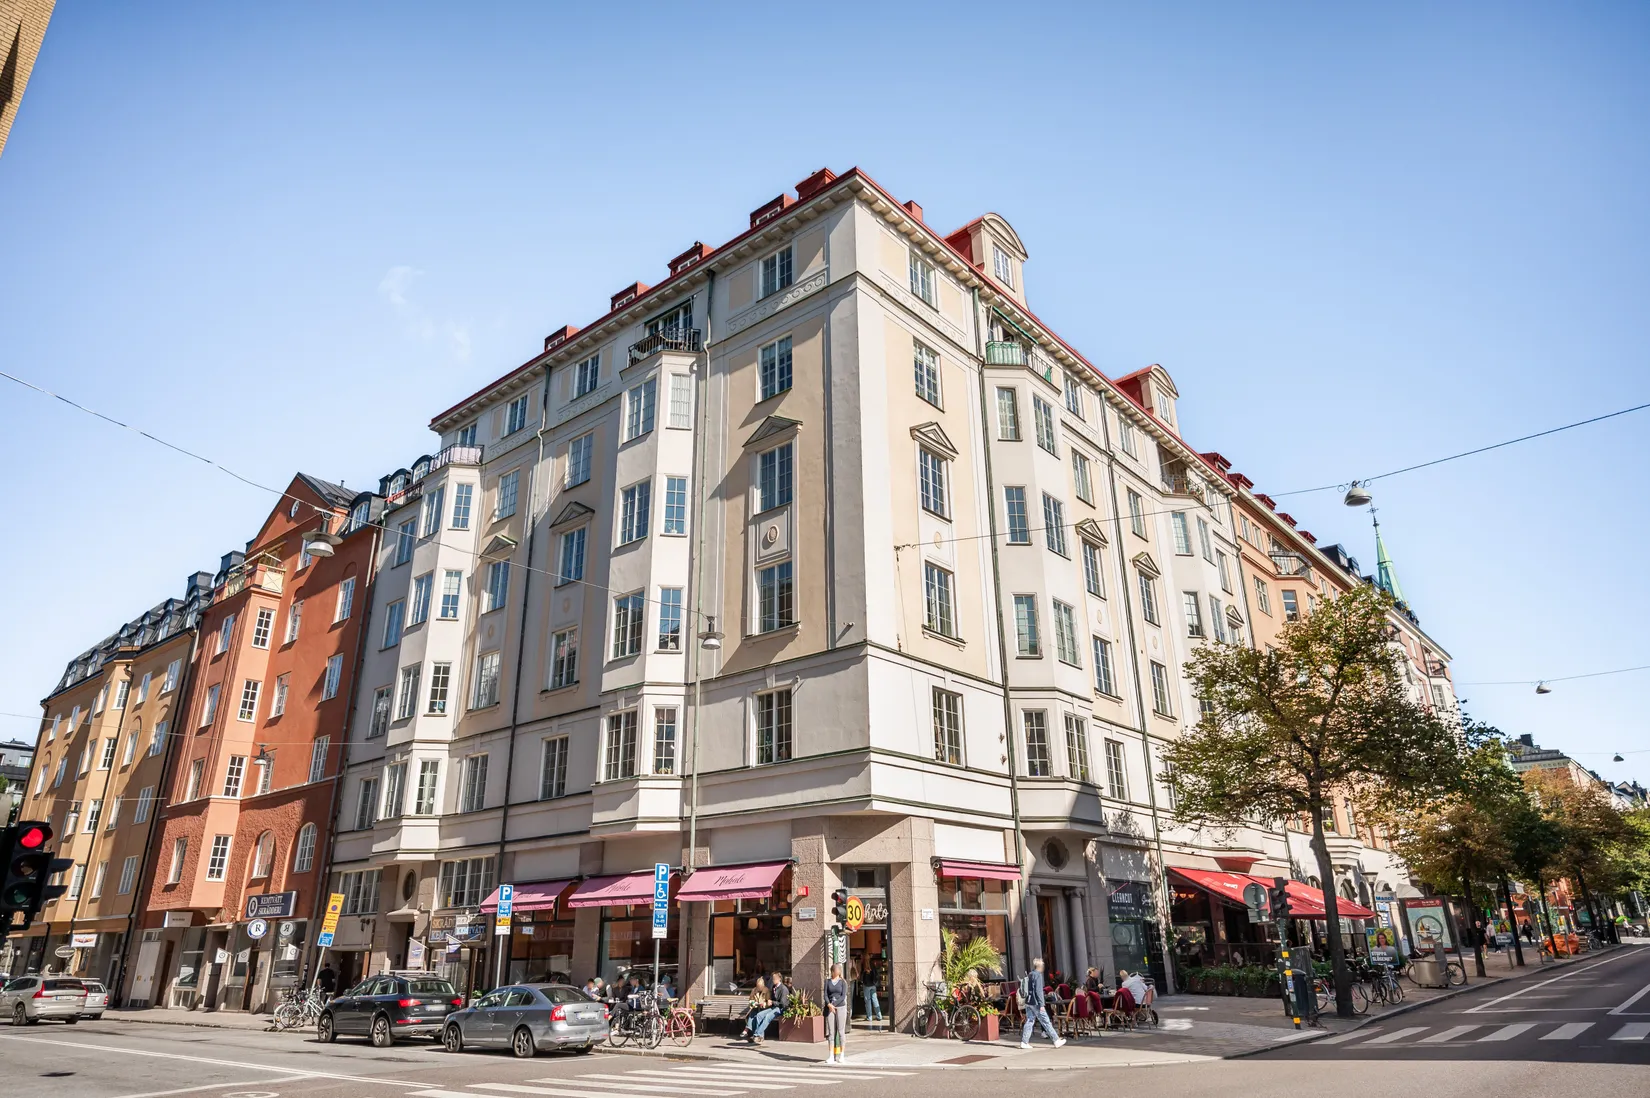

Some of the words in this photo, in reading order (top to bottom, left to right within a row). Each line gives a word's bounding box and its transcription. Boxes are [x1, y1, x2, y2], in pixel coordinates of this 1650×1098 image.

[659, 865, 667, 880] P
[502, 886, 510, 900] P
[848, 905, 861, 920] 30
[255, 924, 261, 932] R
